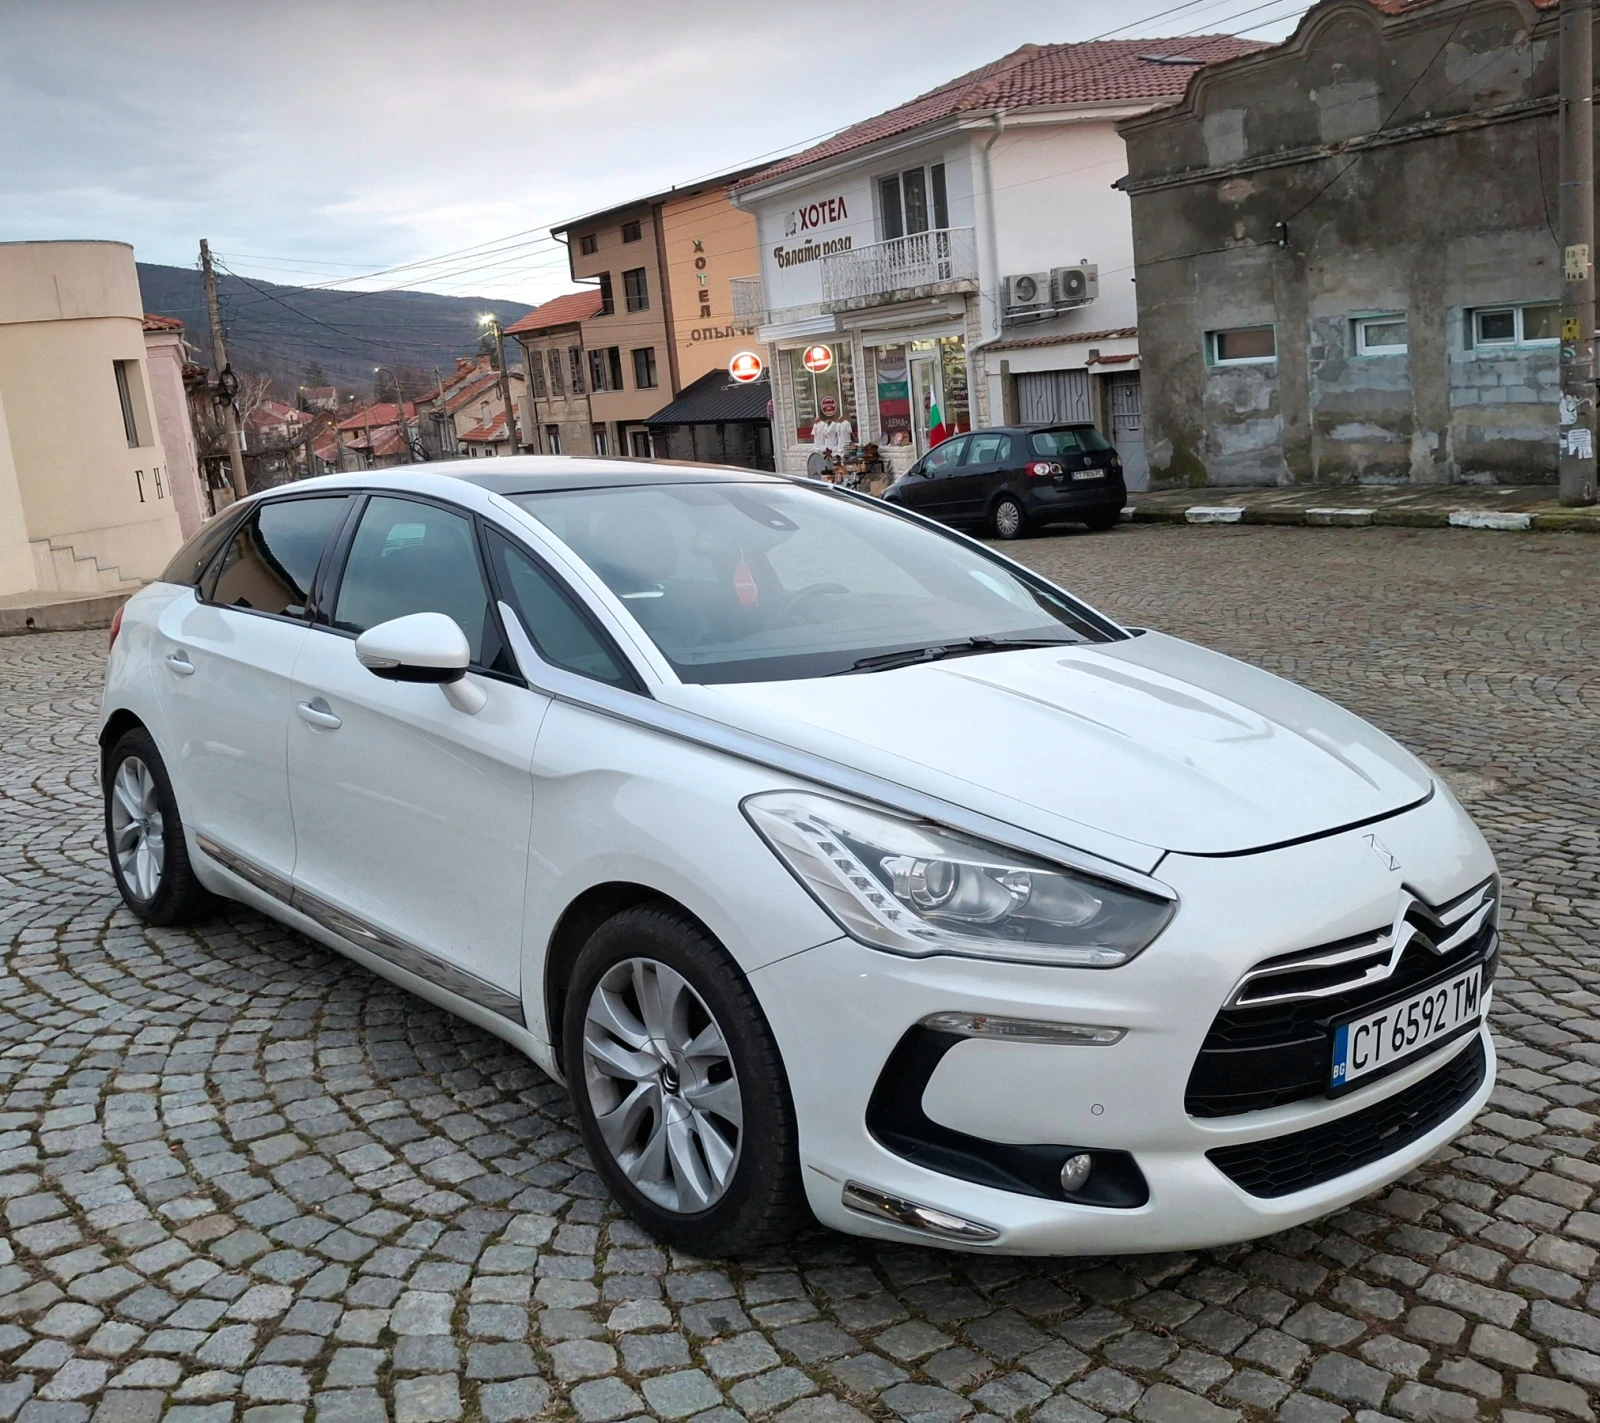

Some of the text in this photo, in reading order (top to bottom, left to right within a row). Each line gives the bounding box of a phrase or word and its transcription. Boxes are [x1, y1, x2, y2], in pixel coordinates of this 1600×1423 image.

[799, 196, 848, 231] ХОТЕЛ
[773, 239, 821, 268] Бялата
[692, 239, 711, 318] ХОТЕЛ
[1352, 972, 1479, 1070] CT 6592 TM
[1332, 1062, 1346, 1079] BG
